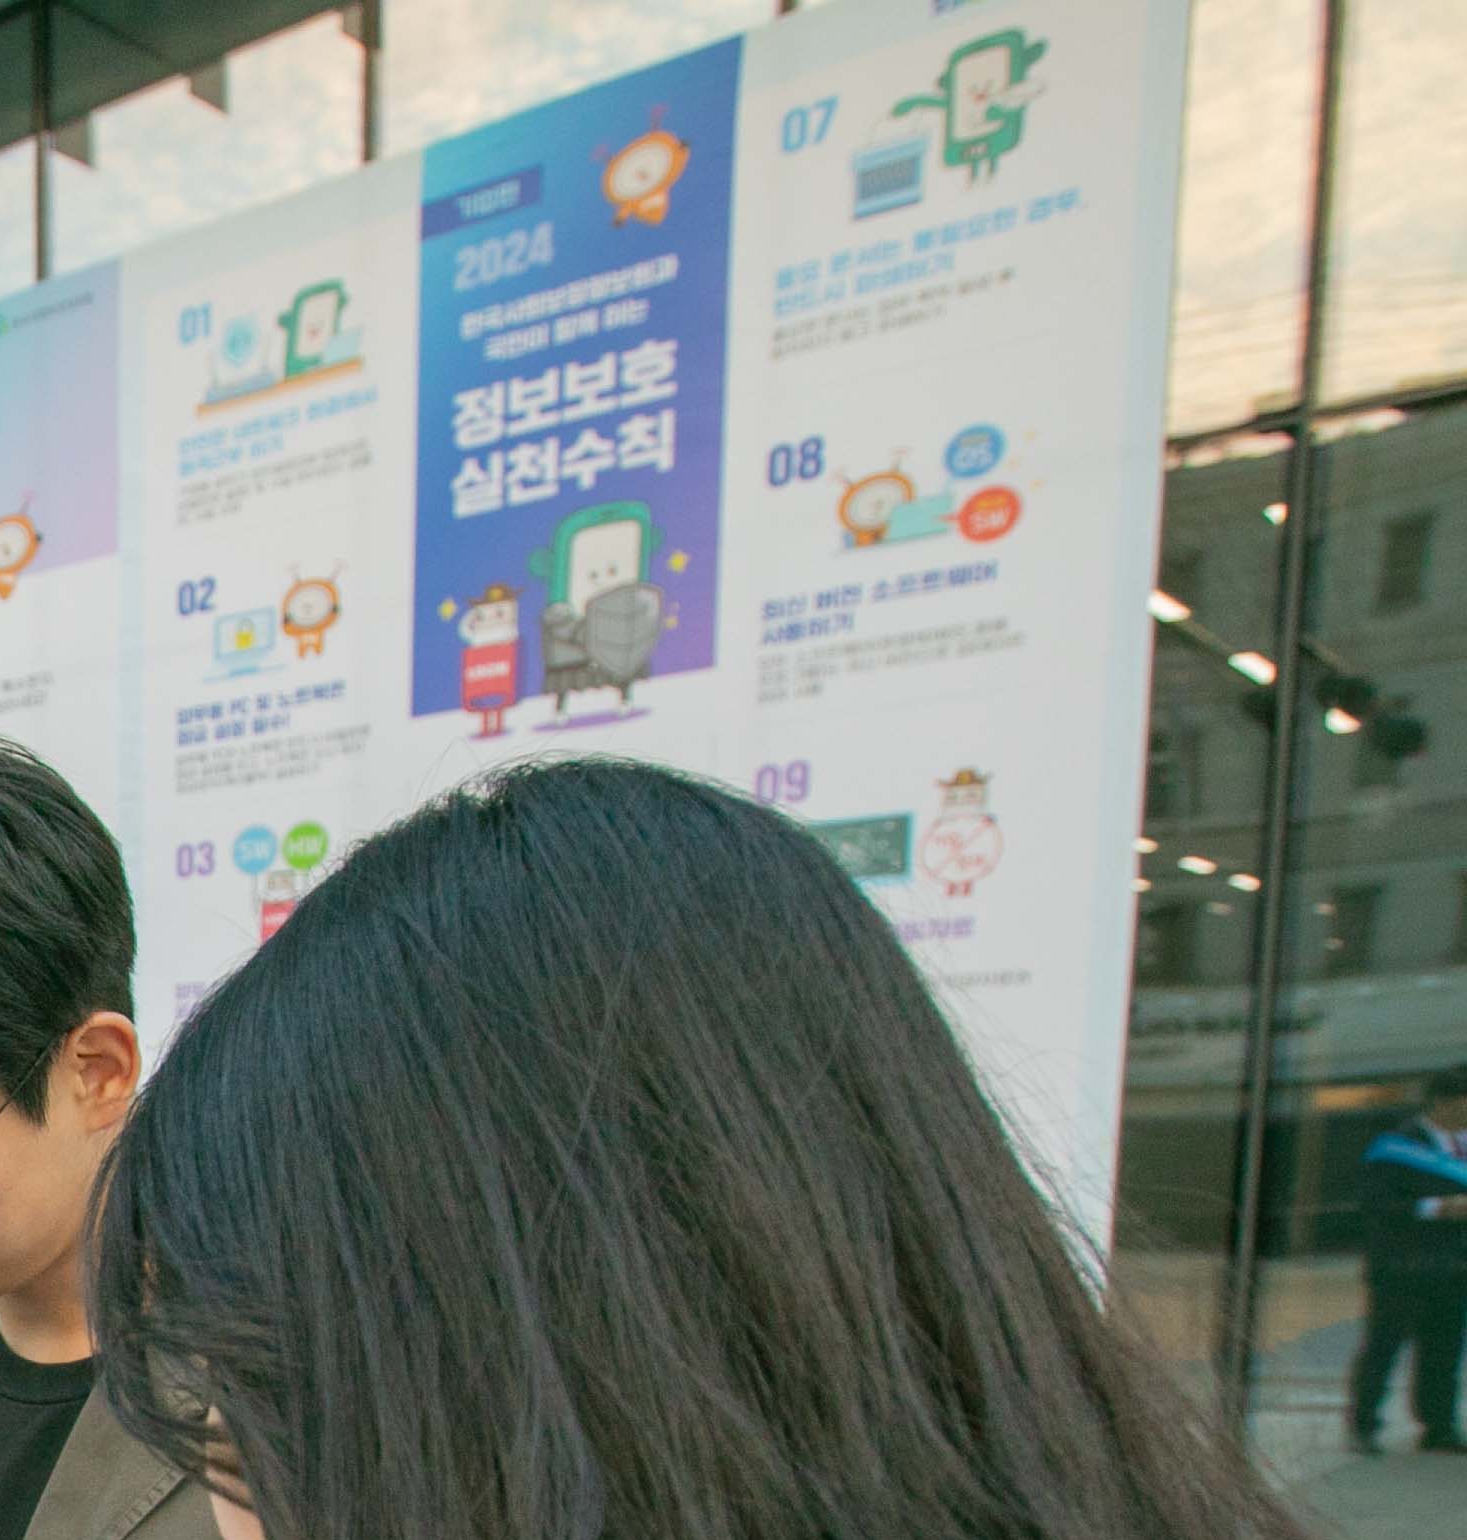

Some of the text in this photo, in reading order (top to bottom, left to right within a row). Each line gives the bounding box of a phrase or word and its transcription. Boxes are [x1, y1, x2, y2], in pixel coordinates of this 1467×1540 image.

[782, 97, 837, 152] 07
[455, 224, 552, 289] 2024
[179, 303, 210, 344] 01
[455, 342, 675, 446] 정보보호
[454, 412, 675, 515] 실천수칙
[768, 437, 823, 486] 08
[178, 577, 215, 616] 02
[754, 762, 808, 808] 09
[177, 841, 215, 877] 03
